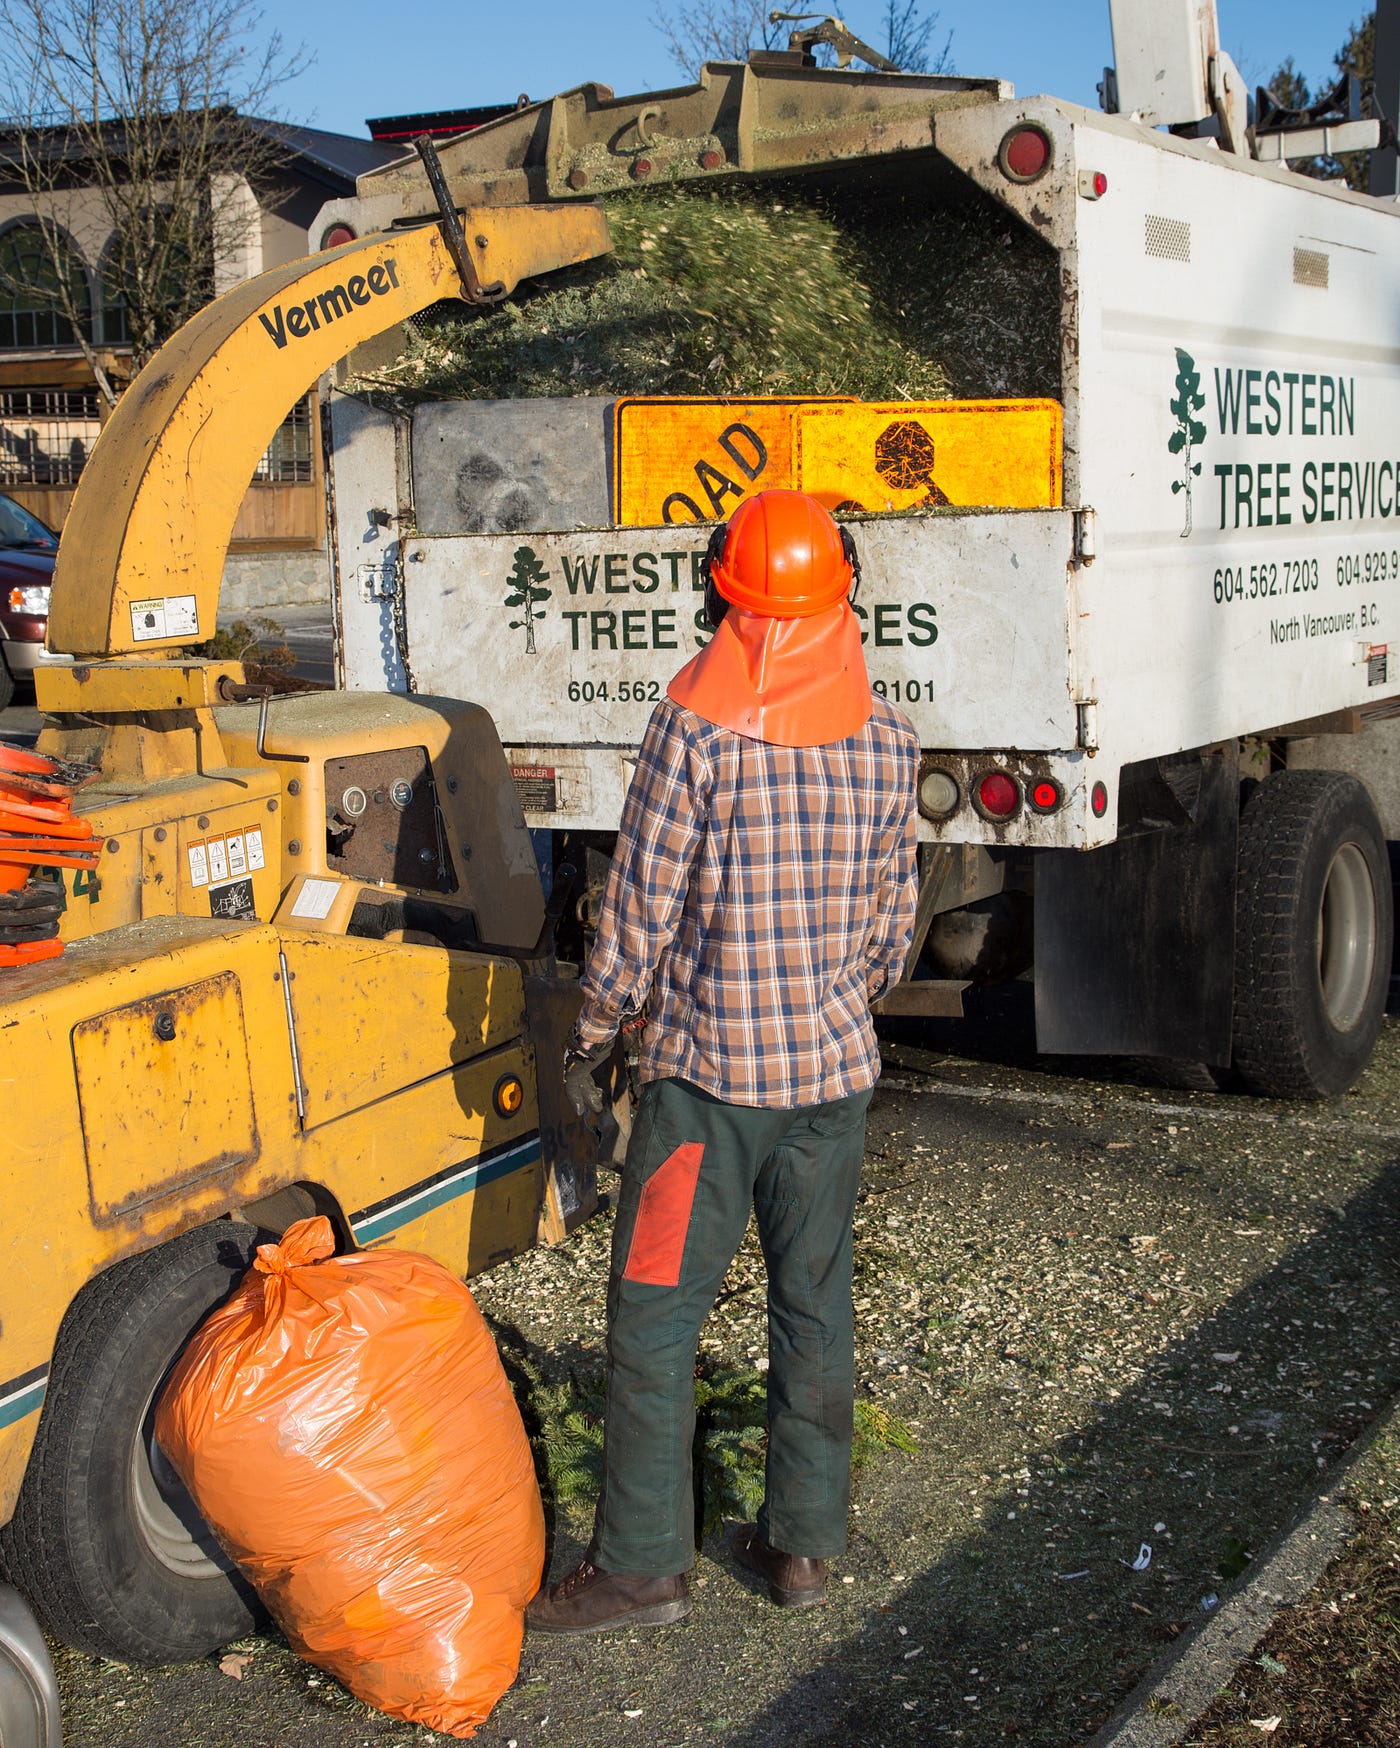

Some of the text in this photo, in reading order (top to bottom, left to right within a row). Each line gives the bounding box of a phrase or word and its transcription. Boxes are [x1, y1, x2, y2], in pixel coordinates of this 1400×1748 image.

[258, 257, 400, 349] Vermeer
[1214, 367, 1354, 436] WESTERN
[662, 422, 768, 524] OAD
[1214, 463, 1292, 530] TREE
[561, 551, 707, 594] WESTE
[1213, 550, 1400, 604] 604.562.7203 604.929.9
[562, 609, 678, 650] TREE
[1270, 602, 1380, 645] North Vancouver, B.C.
[568, 680, 934, 702] 604.562 9101
[513, 768, 548, 778] DANGER
